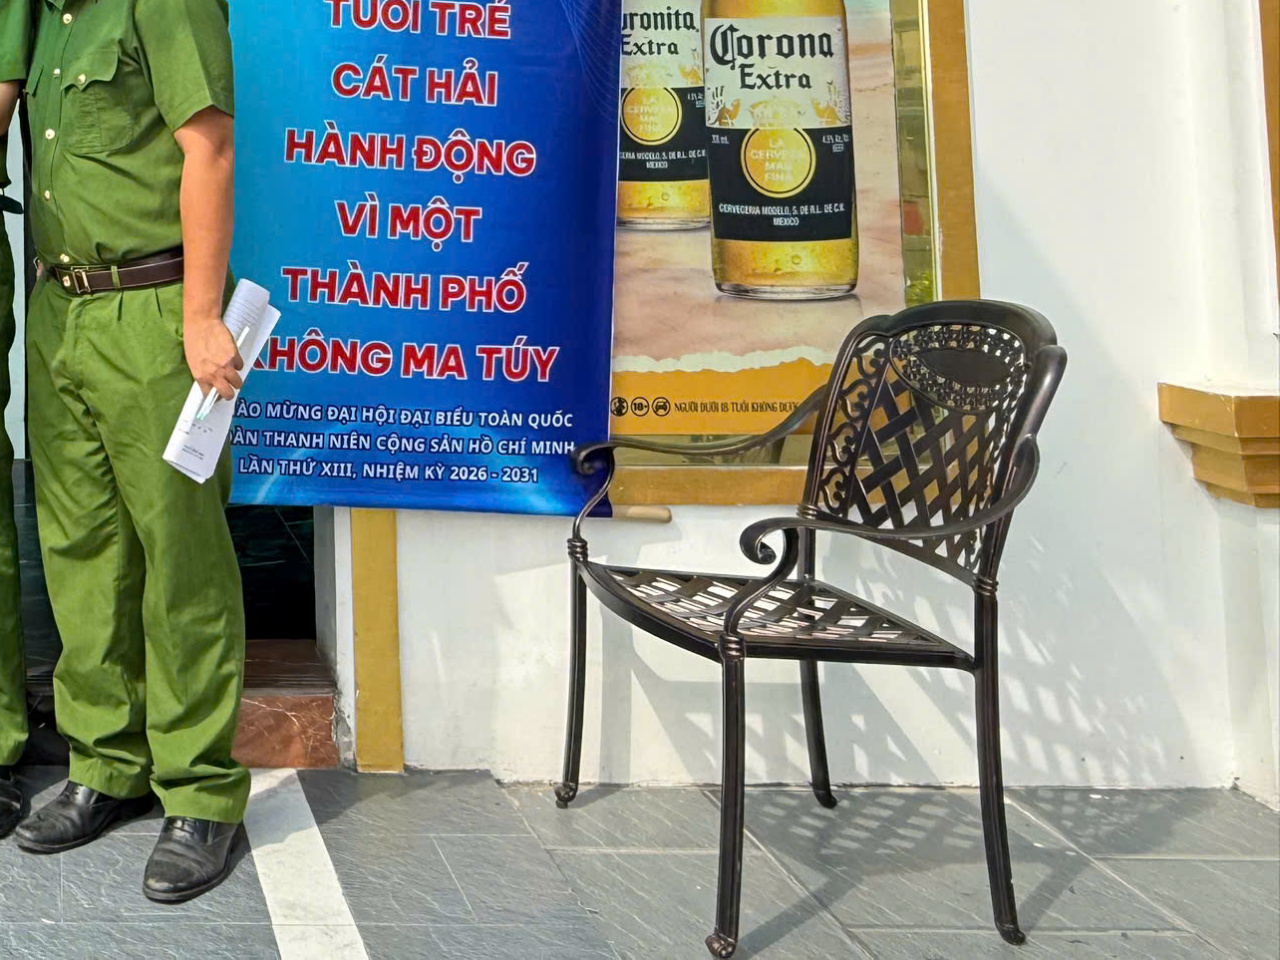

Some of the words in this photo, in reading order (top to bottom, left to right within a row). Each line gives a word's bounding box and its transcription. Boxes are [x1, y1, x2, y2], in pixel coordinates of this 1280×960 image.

[710, 23, 834, 70] Corona
[331, 54, 419, 101] CÁT
[426, 57, 498, 106] HẢI
[738, 63, 812, 90] Extra
[284, 120, 406, 170] HÀNH
[412, 128, 536, 184] ĐỘNG
[334, 192, 379, 238] VÌ
[388, 196, 482, 252] MỘT
[281, 260, 431, 309] THÀNH
[439, 262, 529, 313] PHỐ
[401, 342, 467, 380] MA
[476, 336, 560, 382] TÚY
[266, 400, 322, 420] MỪNG
[327, 406, 357, 425] ĐẠI
[362, 404, 395, 426] HỘI
[400, 409, 430, 428] ĐẠI
[435, 406, 473, 426] BIỂU
[478, 410, 522, 427] TOÀN
[263, 431, 324, 448] THANH
[329, 431, 371, 449] NIÊN
[376, 433, 425, 454] CỘNG
[430, 433, 463, 453] SẢN
[468, 434, 493, 454] HỒ
[498, 437, 526, 454] CHÍ
[531, 440, 575, 455] MINH
[239, 454, 273, 474] LẦN
[278, 457, 316, 475] THỨ
[321, 462, 357, 479] XIII,
[363, 461, 419, 482] NHIỆM
[424, 463, 446, 480] KỲ
[450, 465, 487, 480] 2026
[502, 467, 538, 482] 2031
